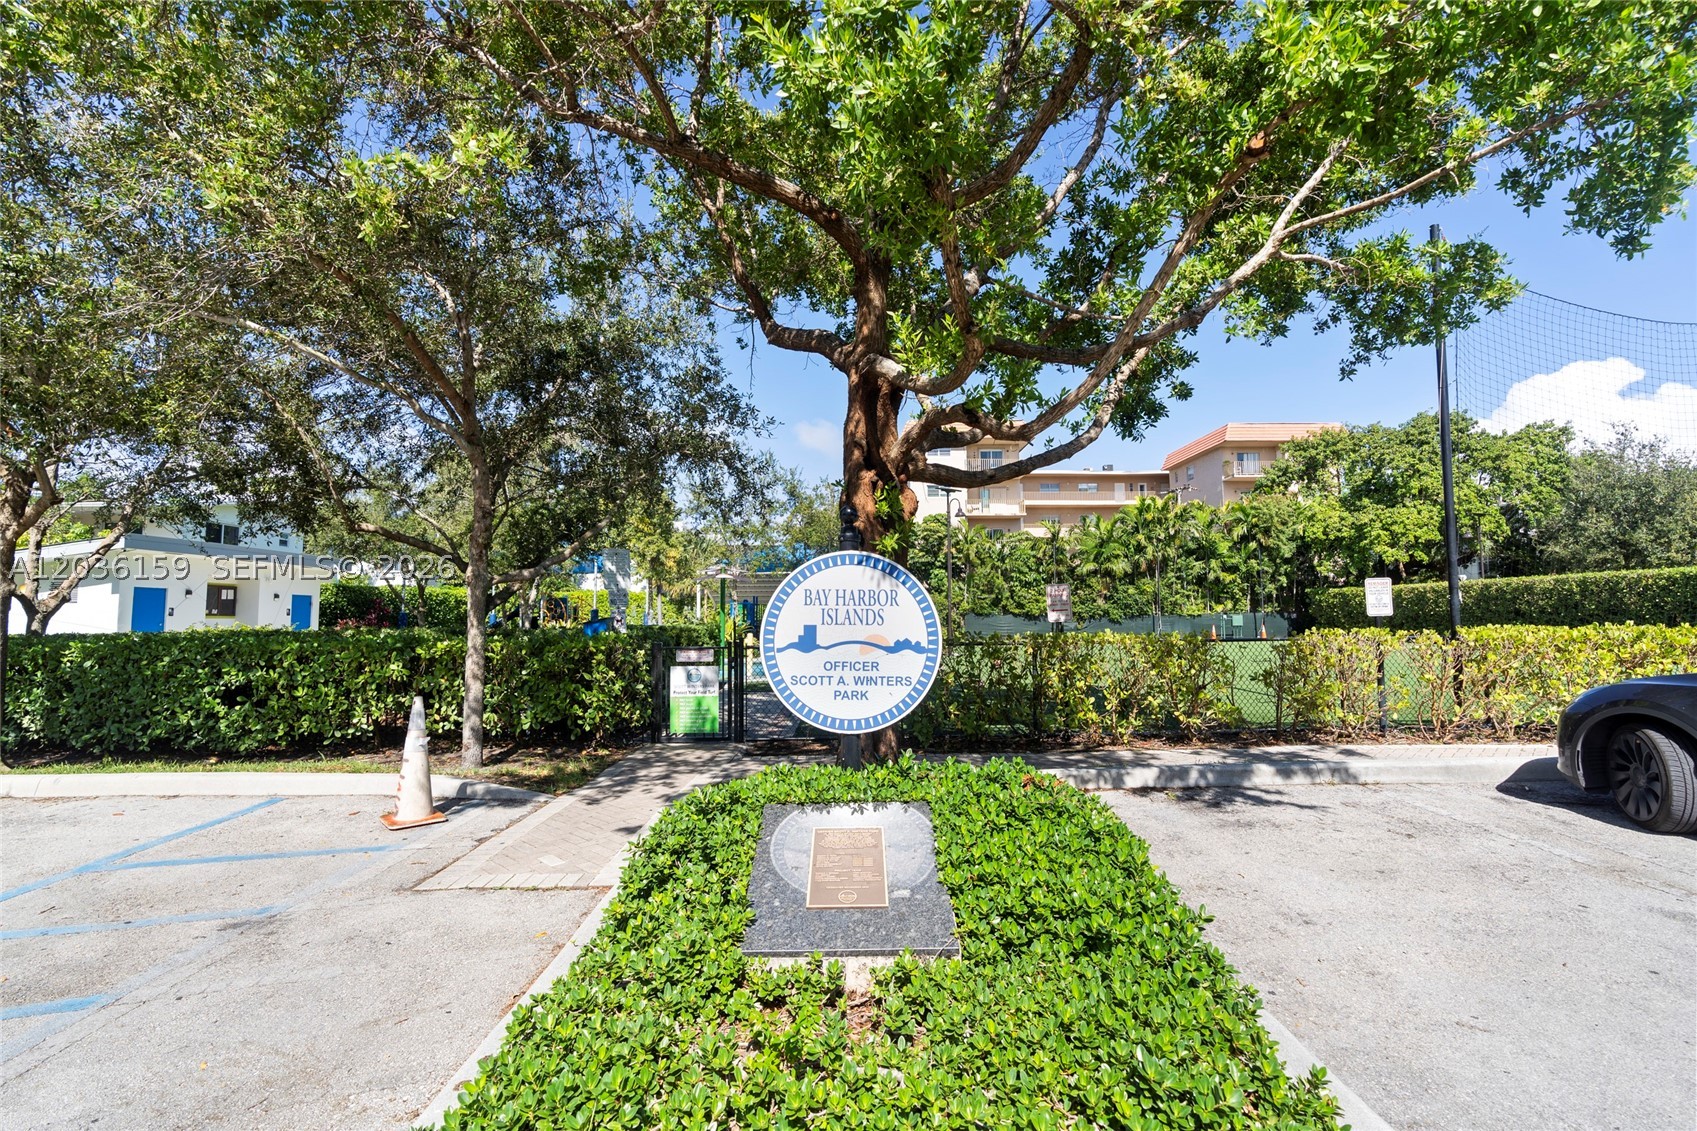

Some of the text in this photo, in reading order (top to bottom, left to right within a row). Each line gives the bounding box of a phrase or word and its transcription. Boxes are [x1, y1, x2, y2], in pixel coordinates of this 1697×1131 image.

[803, 588, 900, 607] BAY HARBOR
[820, 608, 885, 626] ISLANDS
[823, 660, 880, 672] OFFICER
[790, 675, 912, 687] SCOTT A. WINTERS
[833, 690, 869, 701] PARK
